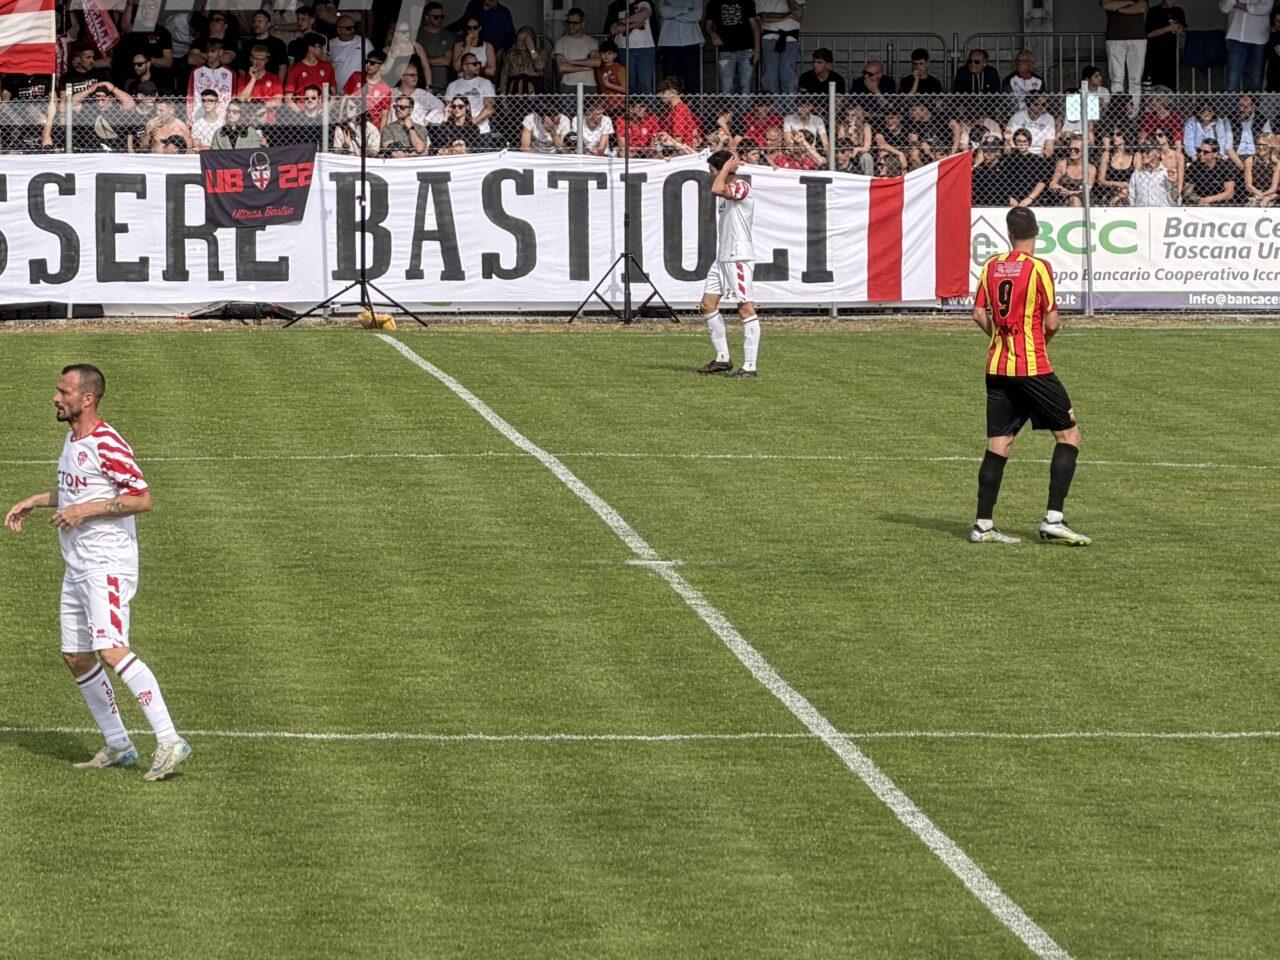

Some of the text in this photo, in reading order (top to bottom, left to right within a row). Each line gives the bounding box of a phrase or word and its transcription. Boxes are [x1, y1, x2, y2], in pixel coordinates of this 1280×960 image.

[278, 162, 315, 189] 22
[1163, 217, 1247, 239] Banca
[1163, 241, 1252, 260] Toscana
[1154, 267, 1250, 284] Cooperativo
[998, 279, 1013, 318] 9
